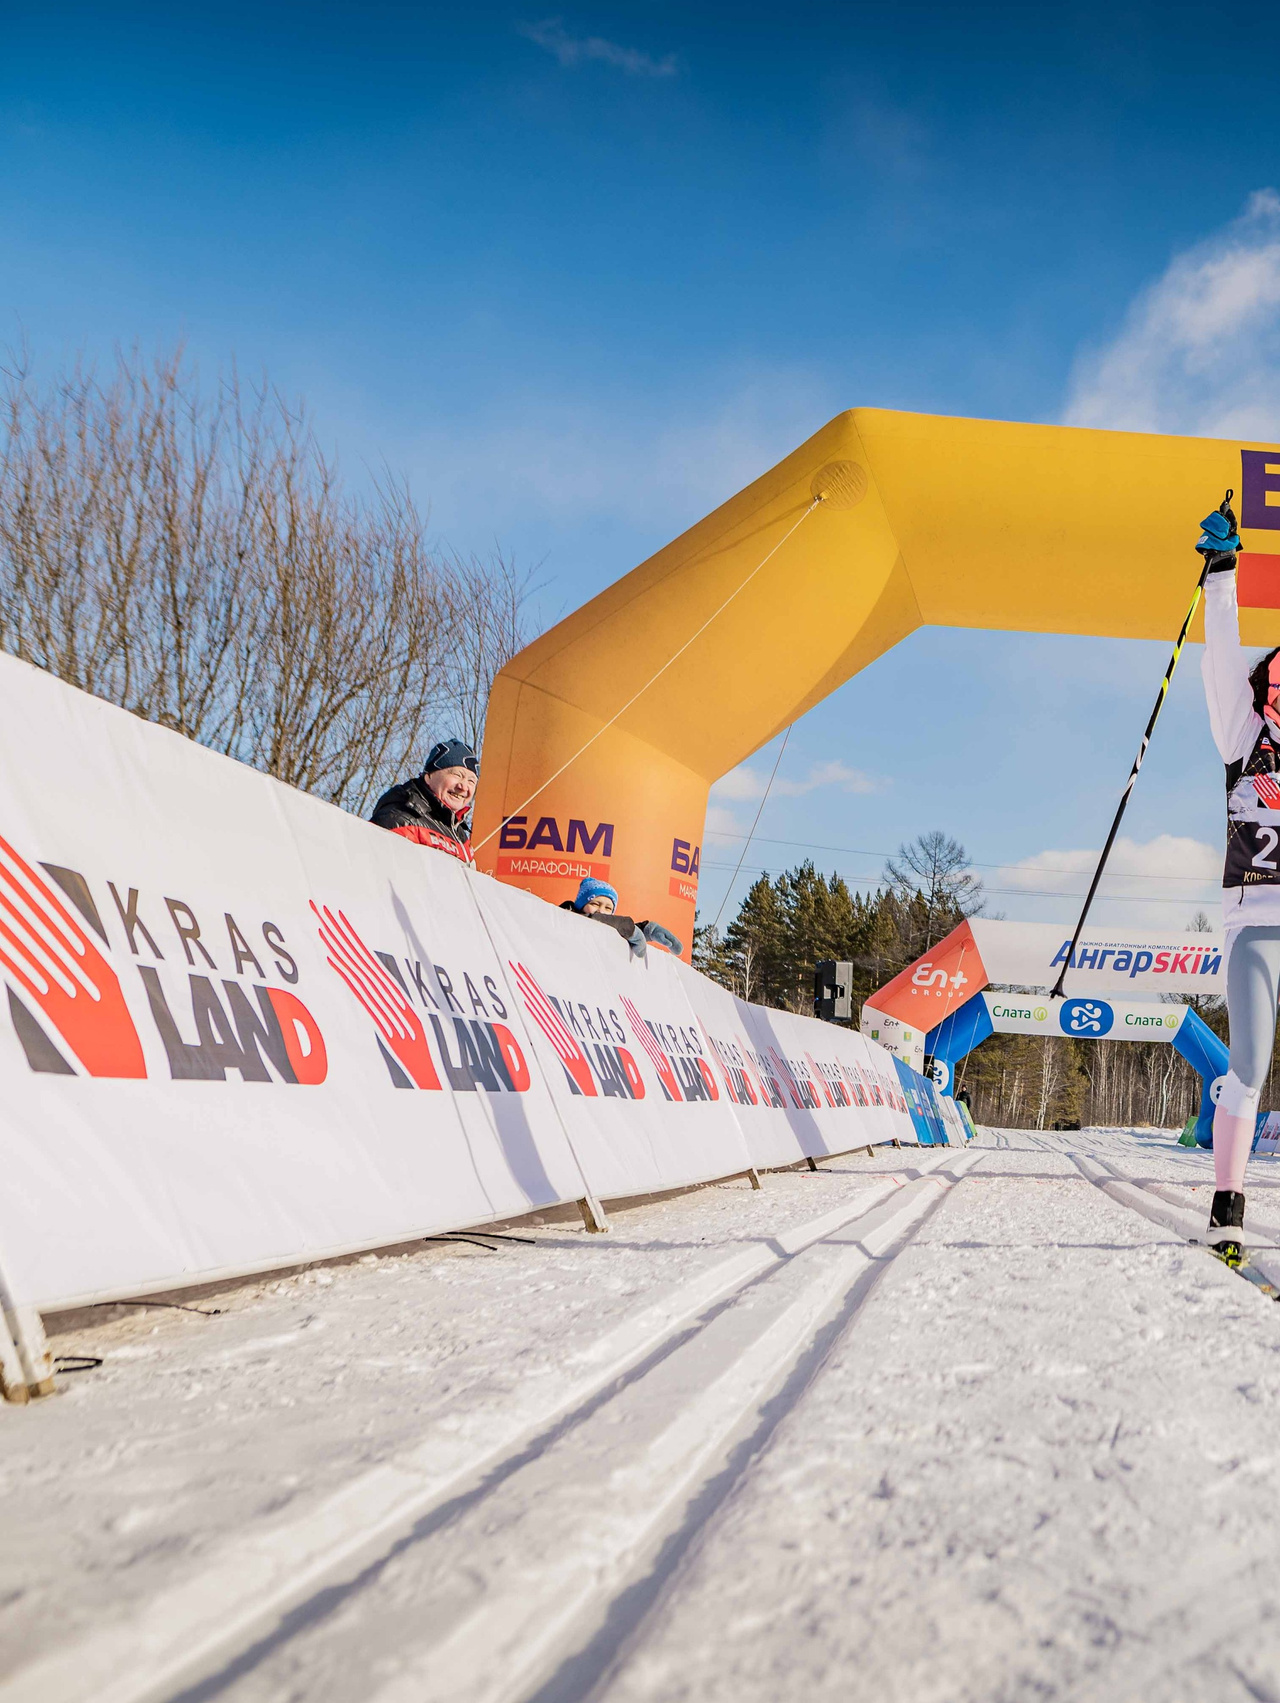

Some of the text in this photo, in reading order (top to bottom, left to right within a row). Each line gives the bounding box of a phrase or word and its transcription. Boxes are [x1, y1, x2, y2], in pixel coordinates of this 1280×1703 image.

[499, 815, 614, 857] БАМ
[510, 859, 592, 878] МАРАФОНЫ
[107, 881, 299, 985] KRAS
[404, 958, 509, 1020] KRAS
[911, 988, 964, 998] GROUP
[137, 964, 329, 1086] LAND
[563, 1000, 627, 1044] KRAS
[992, 1005, 1031, 1020] Слата
[1125, 1013, 1163, 1026] Слата
[428, 1012, 532, 1093] LAND
[655, 1021, 704, 1056] KRAS
[581, 1041, 646, 1100] LAND
[670, 1055, 719, 1101] LAND
[726, 1065, 758, 1106] LAND
